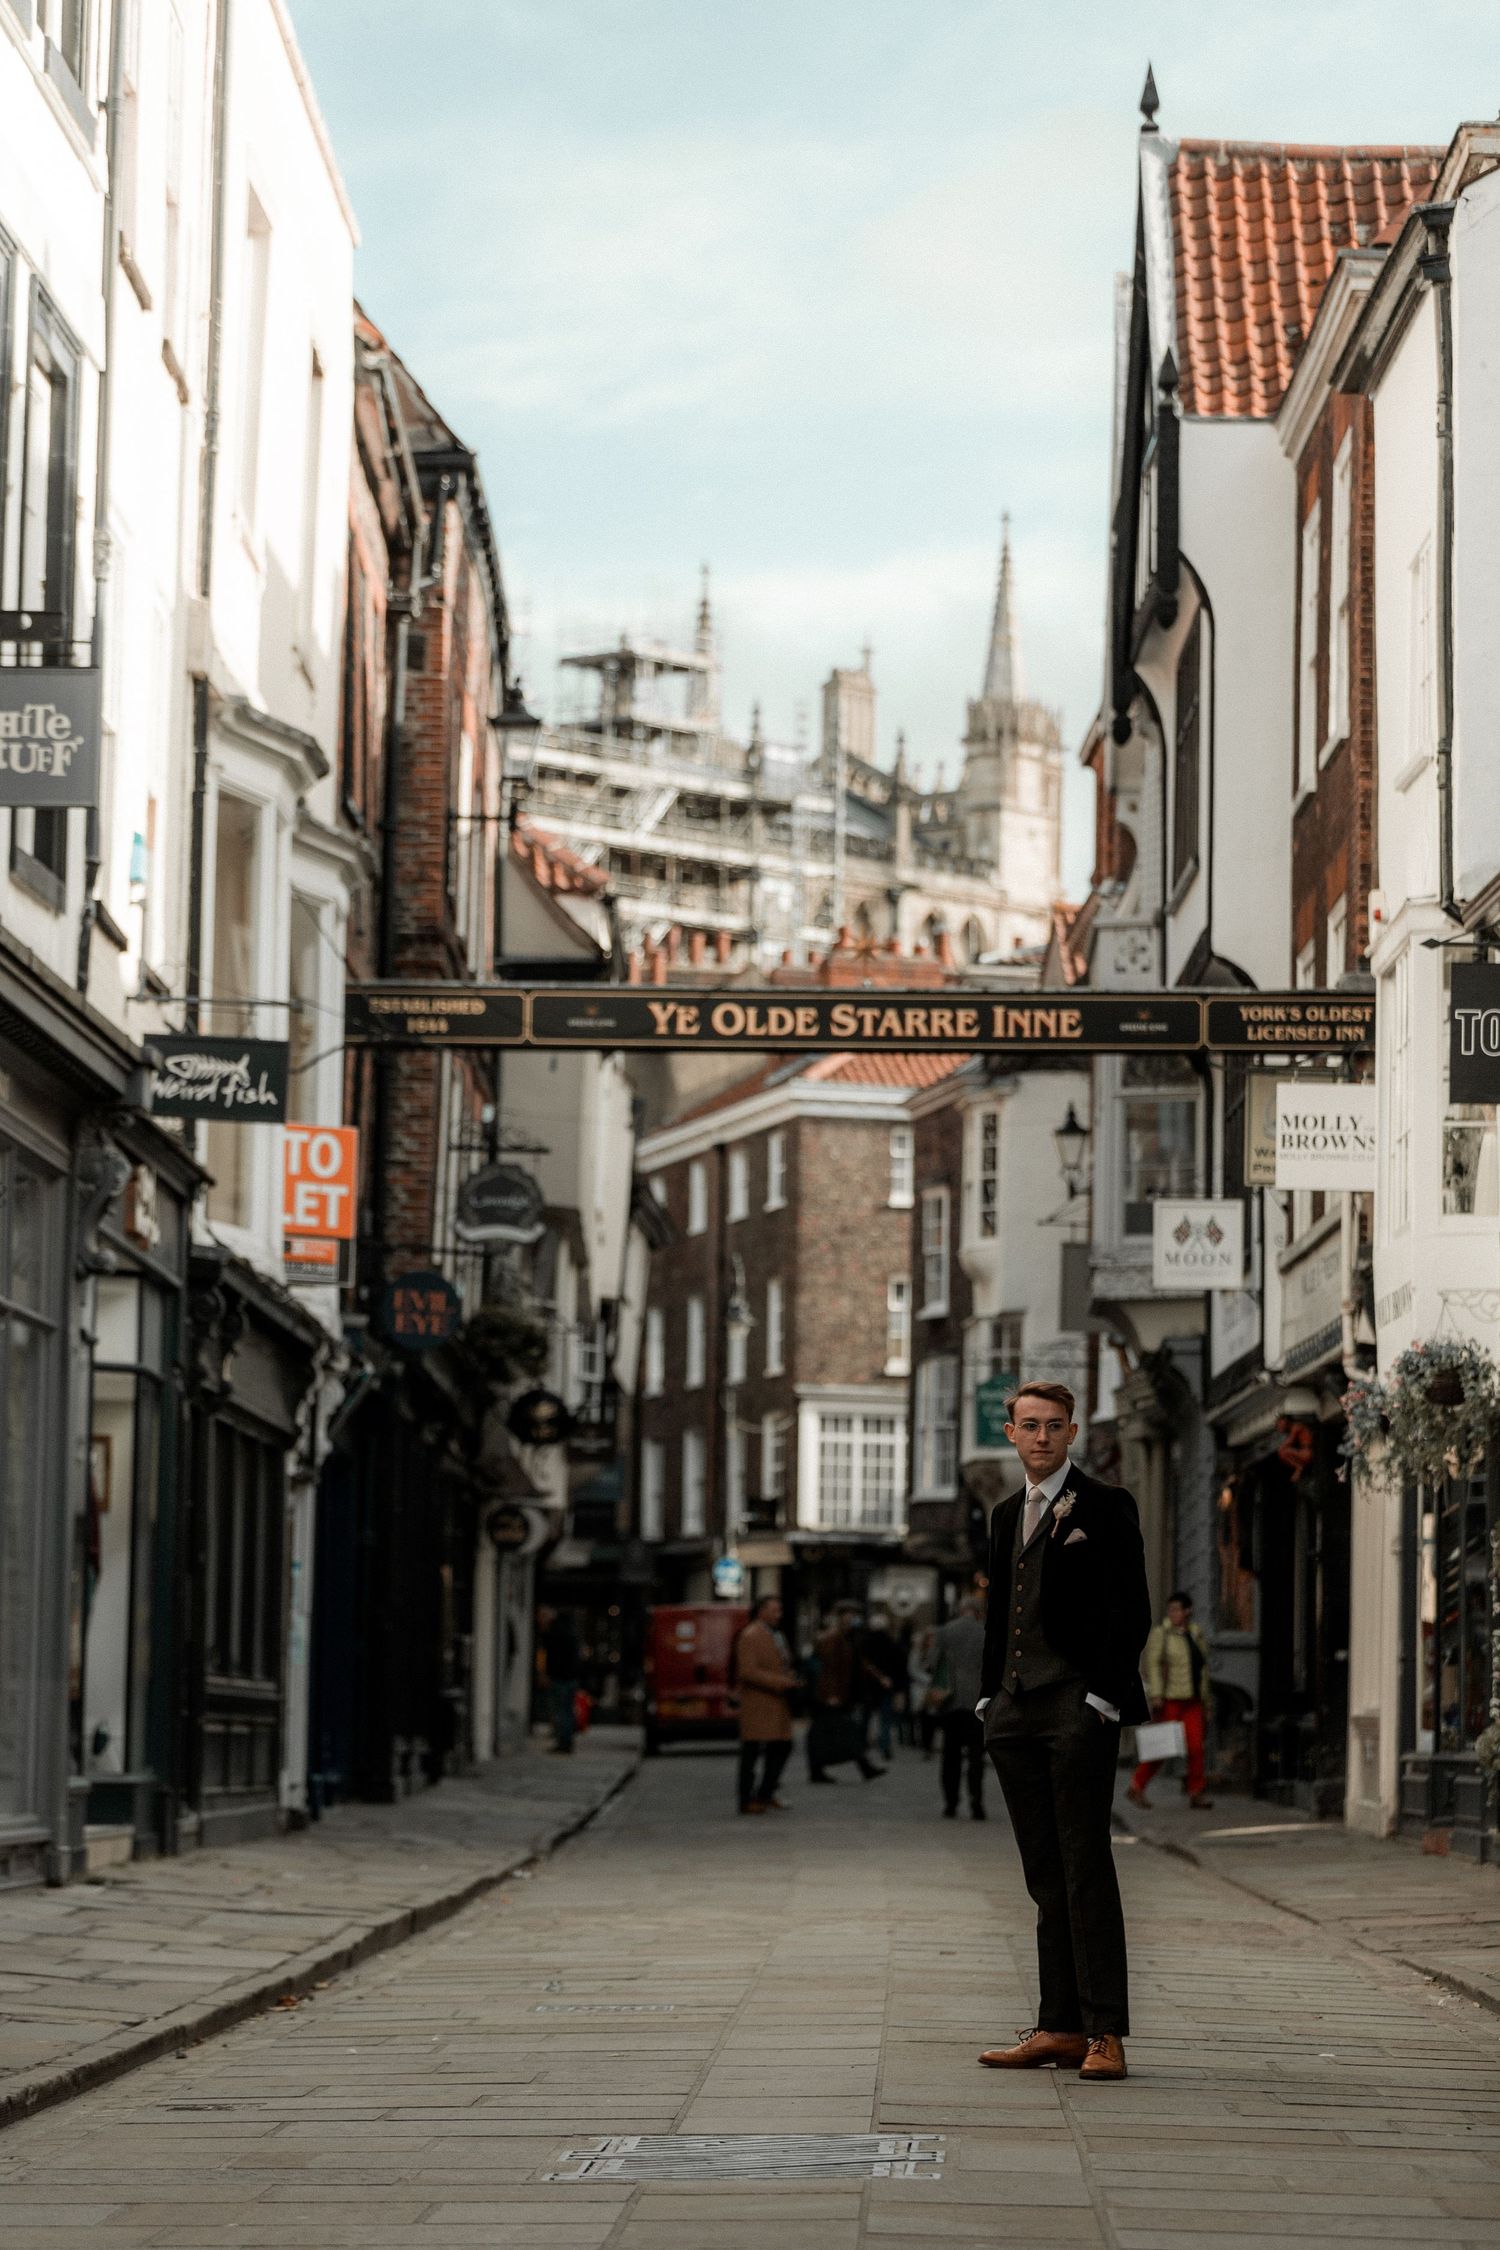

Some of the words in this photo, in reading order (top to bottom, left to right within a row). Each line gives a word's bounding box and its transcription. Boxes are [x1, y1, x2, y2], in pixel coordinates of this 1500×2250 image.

[646, 1001, 701, 1036] YE
[711, 1002, 820, 1036] OLDE
[829, 1003, 980, 1038] STARRE
[991, 1004, 1084, 1039] INNE
[1239, 1005, 1302, 1022] YORK'S
[1305, 1006, 1373, 1023] OLDEST
[1246, 1024, 1331, 1042] LICENSED
[1335, 1024, 1366, 1042] INN
[1280, 1114, 1363, 1131] MOLLY
[284, 1130, 343, 1179] TO
[284, 1181, 349, 1229] ET
[1165, 1251, 1233, 1268] MOON
